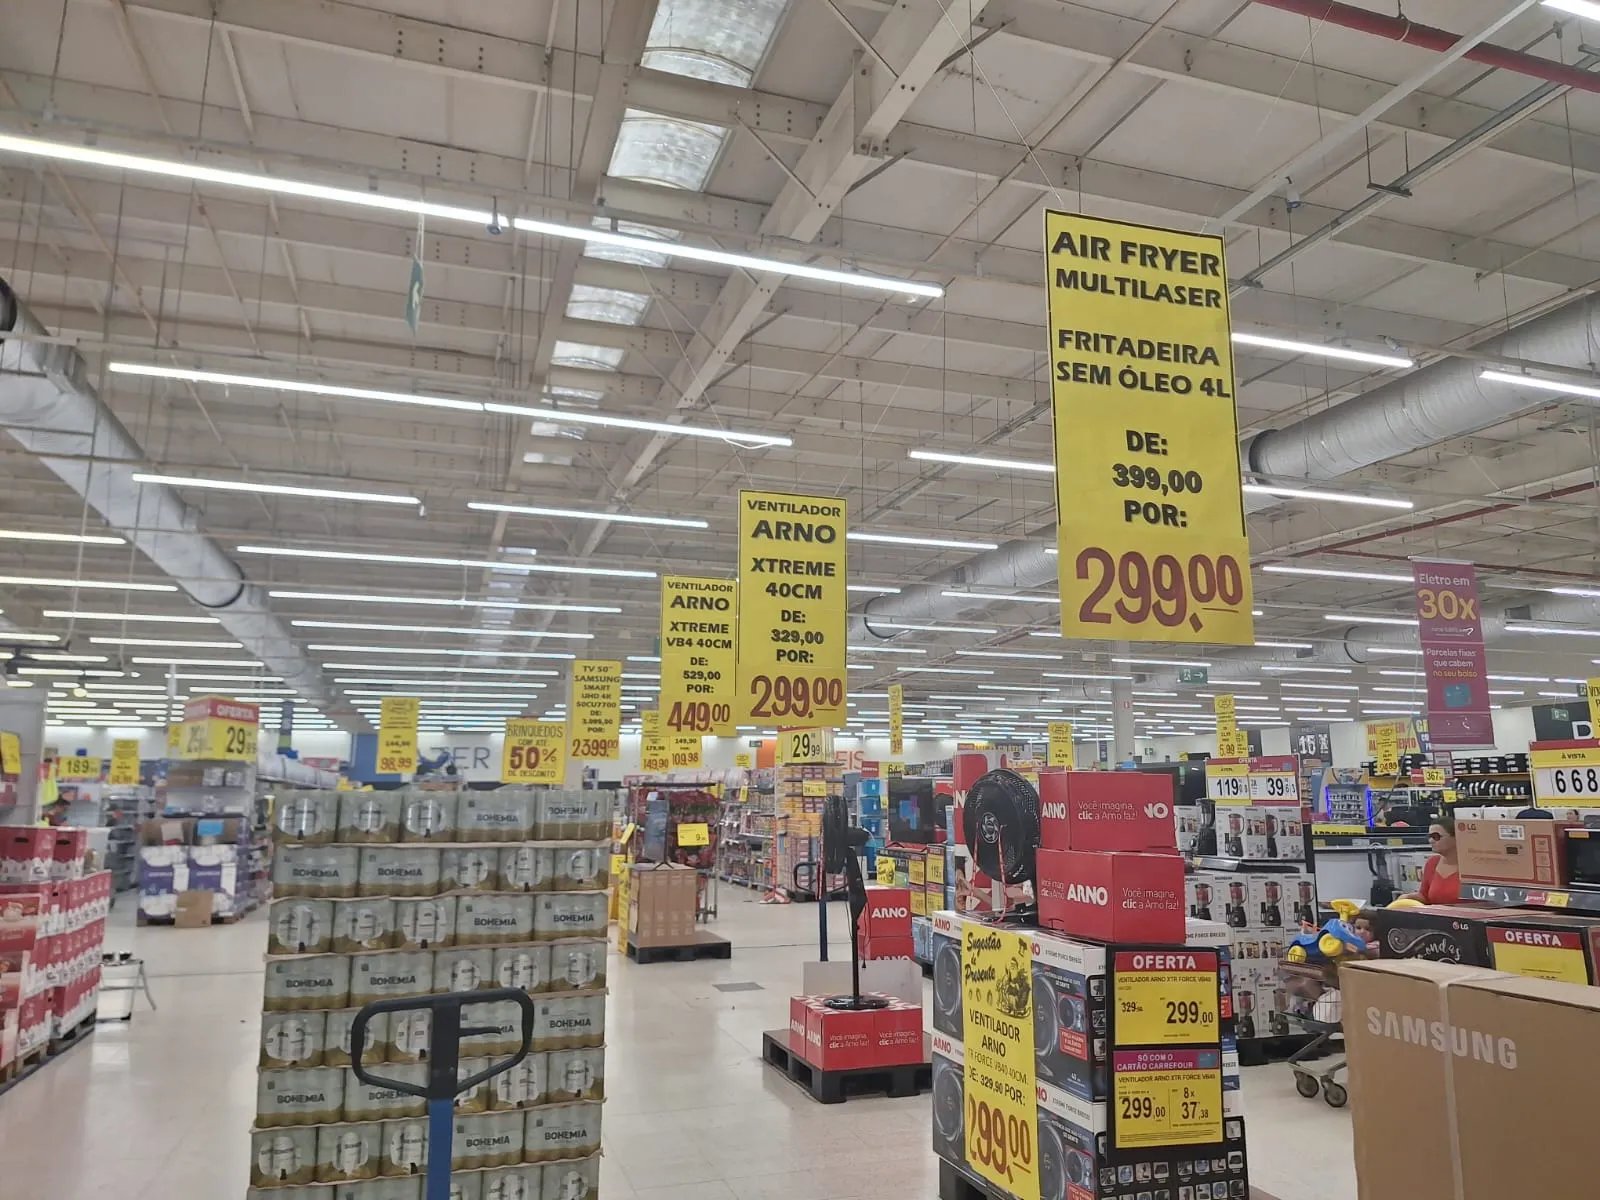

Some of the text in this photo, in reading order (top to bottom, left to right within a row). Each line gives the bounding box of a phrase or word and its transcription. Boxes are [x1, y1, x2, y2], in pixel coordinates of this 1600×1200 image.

[1051, 231, 1220, 277] AIR FRYER
[1055, 268, 1221, 309] MULTILASER
[1058, 329, 1220, 366] FRITADEIRA
[1056, 361, 1231, 399] SEM ÓLEO 4L
[1126, 429, 1168, 456] DE:
[1112, 463, 1202, 496] 399,00
[747, 500, 841, 518] VENTILADOR
[1124, 500, 1187, 528] POR:
[751, 519, 836, 544] ARNO
[750, 557, 836, 577] XTREME
[667, 581, 733, 593] VENTILADOR
[1419, 573, 1470, 587] Eletro em
[765, 582, 822, 600] 40CM
[670, 595, 730, 611] ARNO
[1416, 589, 1477, 620] 30x
[781, 609, 806, 624] DE:
[669, 621, 729, 635] XTREME
[696, 638, 732, 649] 40CM
[771, 629, 824, 646] 329,00
[776, 649, 814, 664] POR:
[1426, 648, 1457, 657] Parcelas
[690, 657, 708, 667] DE:
[1448, 660, 1473, 668] cabem
[574, 675, 620, 683] SAMSUNG
[683, 670, 721, 681] 529,00
[686, 683, 714, 694] POR:
[507, 724, 563, 738] BRINQUEDOS
[226, 726, 246, 754] 29
[792, 733, 811, 758] 29
[1216, 778, 1239, 796] 119
[1267, 777, 1284, 796] 39
[1042, 802, 1066, 820] ARNO
[1078, 800, 1097, 810] Você
[1078, 811, 1093, 821] clic
[1101, 811, 1122, 821] Arno
[1467, 823, 1477, 831] LG
[292, 868, 339, 877] BOHEMIA
[378, 867, 423, 876] BOHEMIA
[1067, 883, 1108, 906] ARNO
[1122, 887, 1177, 901] Você imagina,
[1122, 899, 1180, 910] clic a Arno faz!
[553, 913, 594, 922] BOHEMIA
[871, 906, 907, 919] ARNO
[474, 917, 517, 926] BOHEMIA
[934, 918, 951, 931] ARNO
[967, 931, 1001, 958] Sugestão
[1504, 930, 1562, 947] OFERTA
[971, 952, 976, 965] de
[1132, 955, 1197, 970] OFERTA
[370, 976, 416, 985] BOHEMIA
[965, 963, 995, 987] Presente
[286, 978, 334, 988] BOHEMIA
[550, 1018, 591, 1028] BOHEMIA
[790, 1019, 805, 1036] ARNO
[969, 1007, 1020, 1043] VENTILADOR
[807, 1029, 821, 1047] ARNO
[933, 1036, 951, 1054] ARNO
[981, 1034, 1006, 1057] ARNO
[1366, 1006, 1518, 1070] SAMSUNG
[974, 1051, 993, 1068] FORCE
[1137, 1053, 1148, 1062] SÓ
[1167, 1053, 1173, 1061] O
[1116, 1061, 1194, 1071] CARTÃO CARREFOUR
[1118, 1075, 1153, 1083] VENTILADOR
[980, 1074, 1026, 1106] 329,90 POR:
[277, 1093, 325, 1104] BOHEMIA
[466, 1135, 511, 1147] BOHEMIA
[544, 1129, 588, 1140] BOHEMIA
